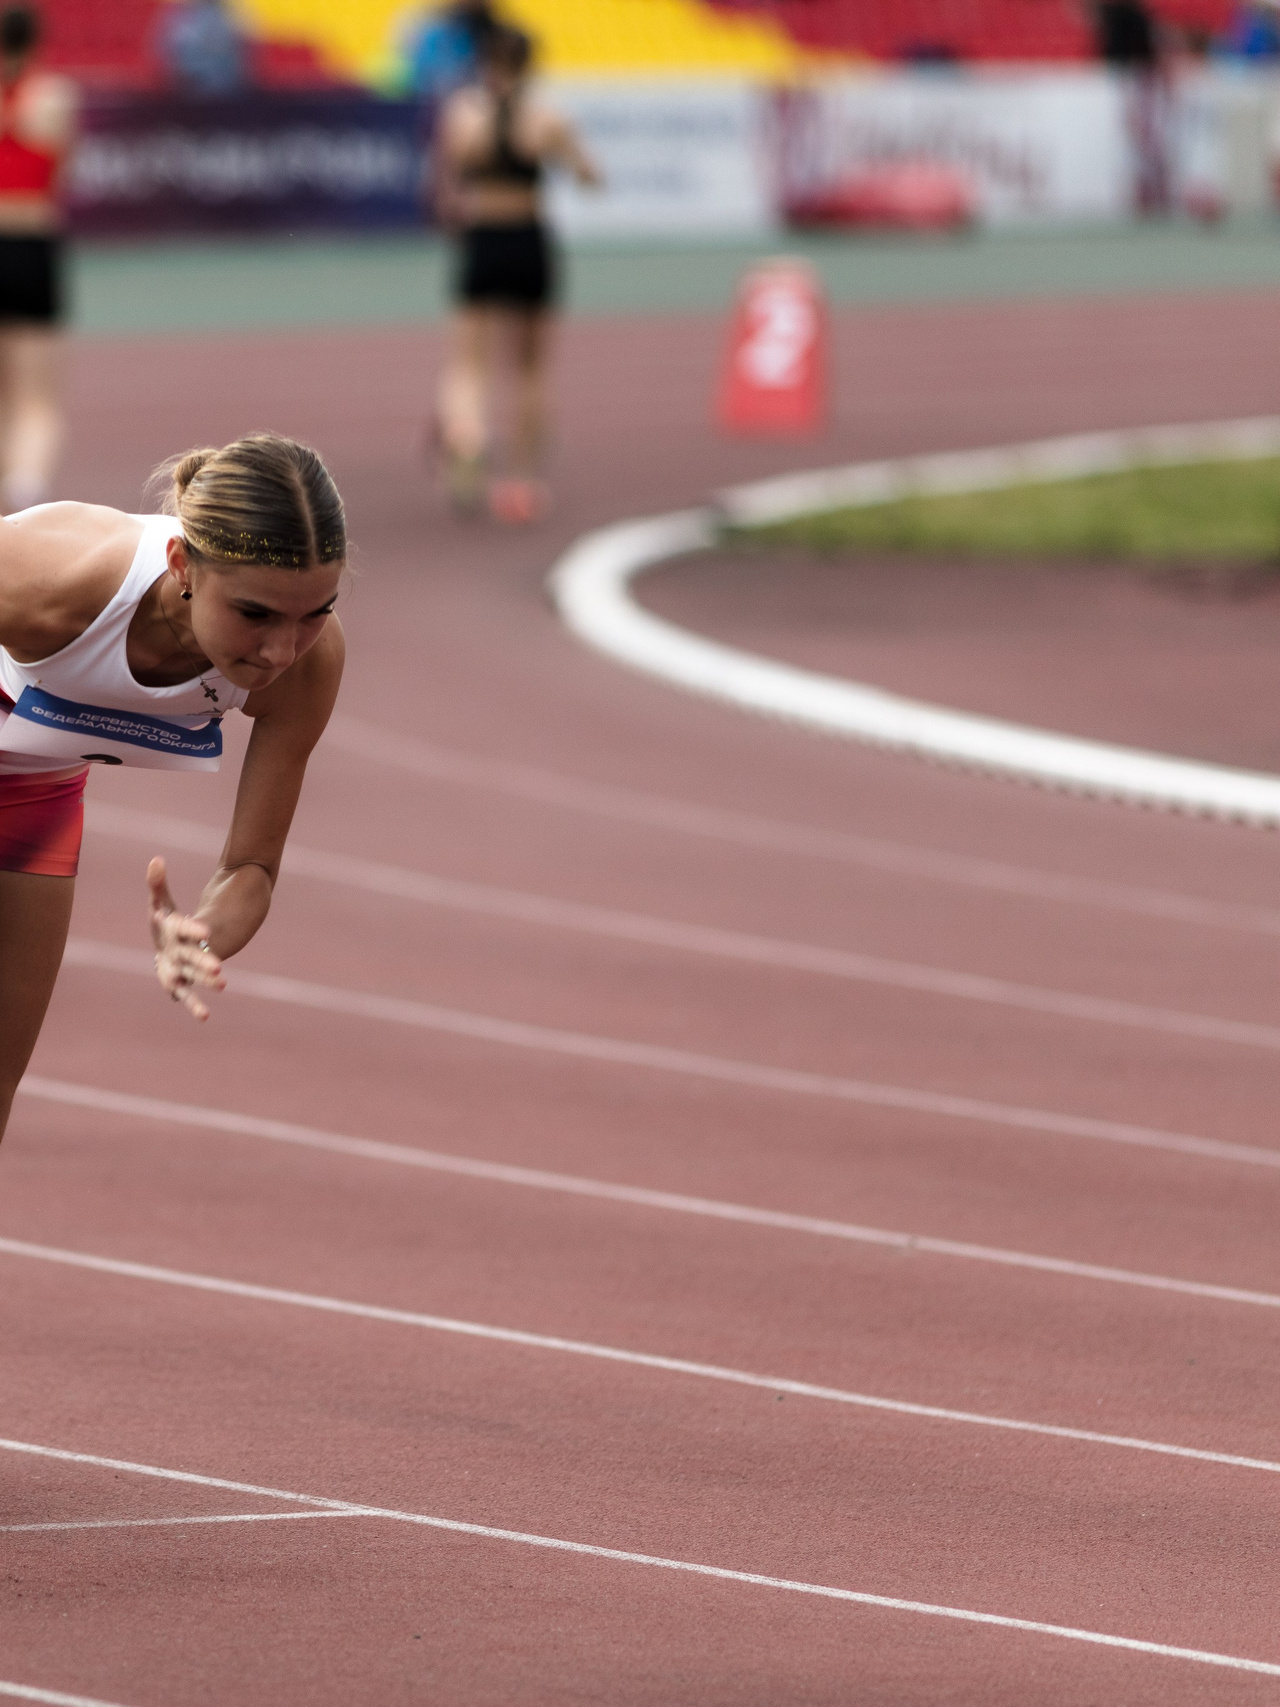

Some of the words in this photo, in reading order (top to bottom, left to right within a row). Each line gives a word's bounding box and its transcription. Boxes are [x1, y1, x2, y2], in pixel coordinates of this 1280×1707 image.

[31, 706, 158, 741] ФЕДЕРАЛЬНОГО
[159, 738, 216, 751] ОКРУГА
[79, 712, 182, 741] ПЕРВЕНСТВО
